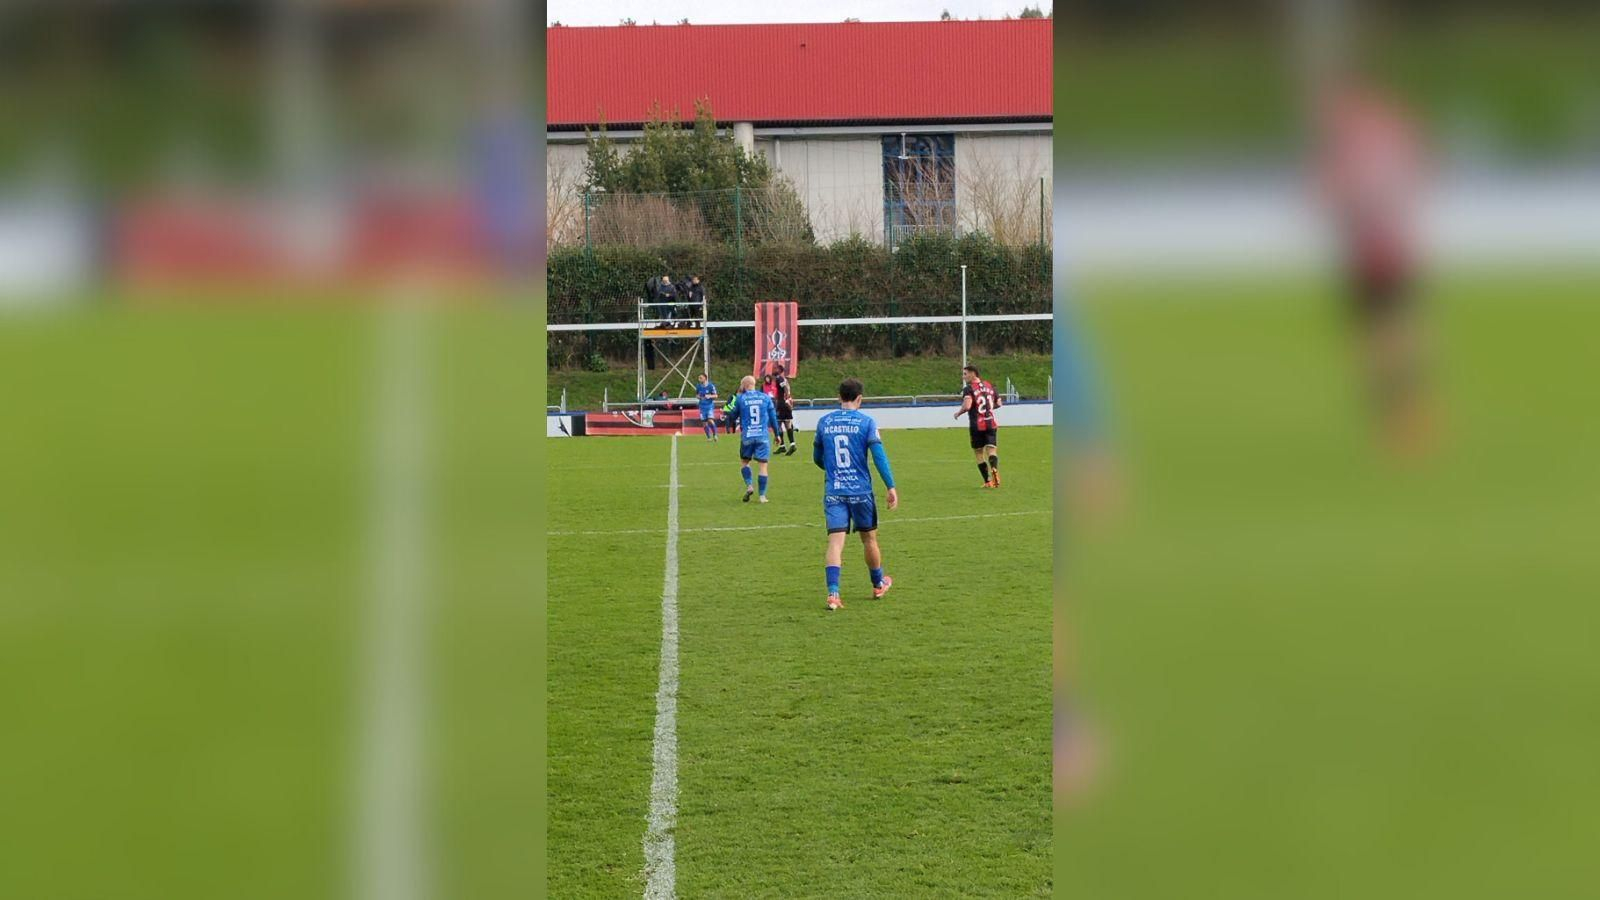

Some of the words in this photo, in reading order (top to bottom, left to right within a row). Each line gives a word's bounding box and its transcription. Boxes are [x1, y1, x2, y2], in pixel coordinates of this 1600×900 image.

[977, 395, 994, 414] 21
[749, 405, 760, 425] 9
[829, 425, 859, 434] CASTILLO
[834, 435, 851, 468] 6
